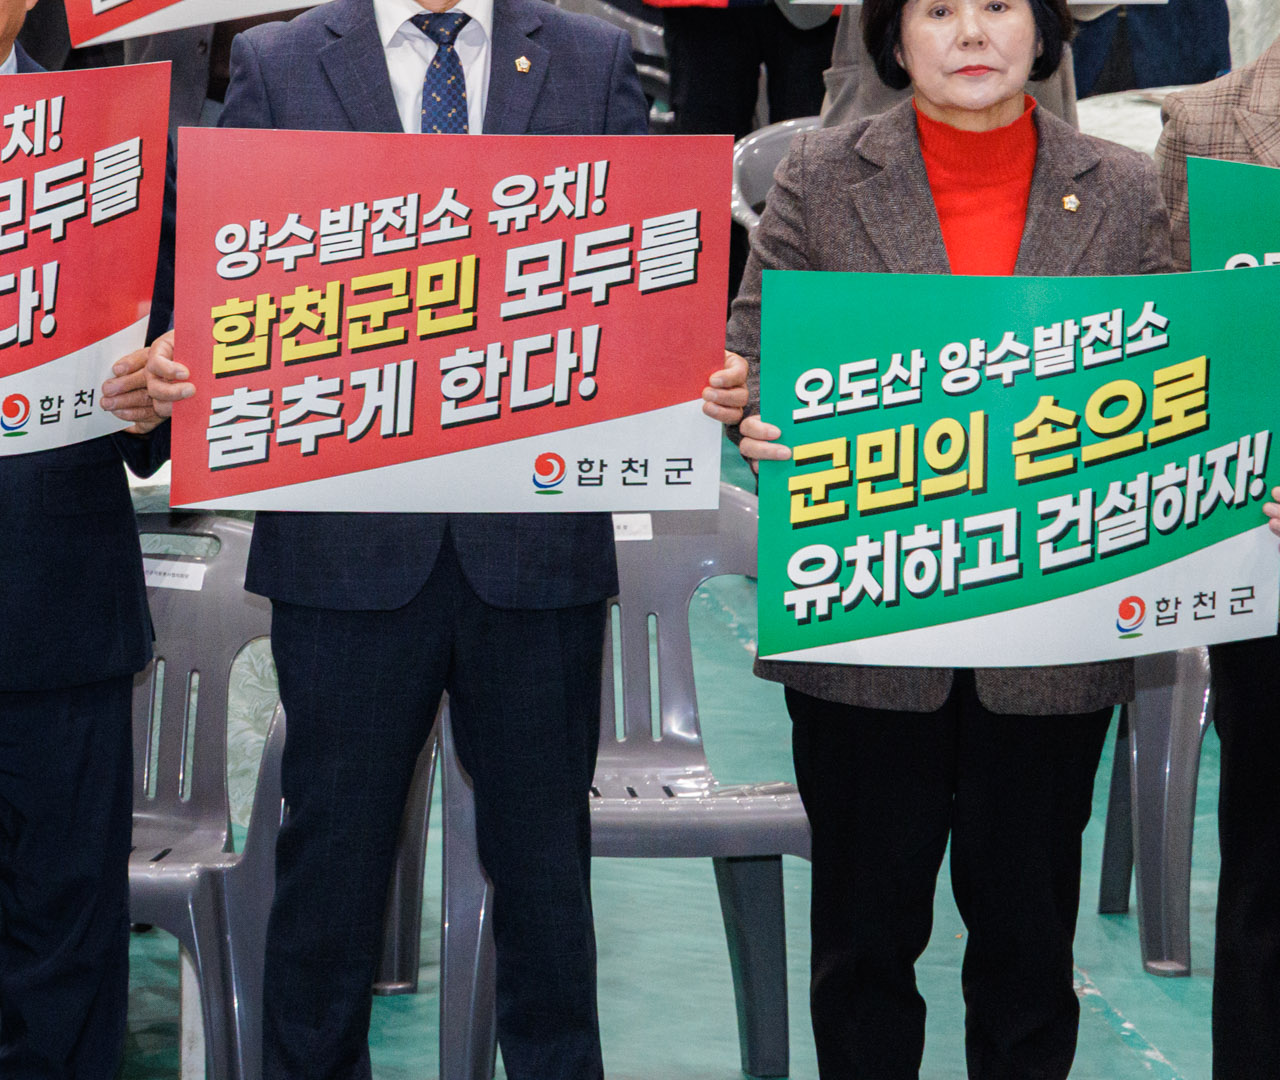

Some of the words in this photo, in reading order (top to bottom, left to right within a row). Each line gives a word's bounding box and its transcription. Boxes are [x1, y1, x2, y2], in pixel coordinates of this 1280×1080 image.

[213, 188, 473, 280] 양수발전소
[487, 160, 609, 234] 유치!
[210, 254, 478, 376] 합천군민
[499, 208, 700, 320] 모두를
[206, 359, 416, 471] 춤추게
[439, 325, 601, 427] 한다!
[791, 349, 926, 422] 오도산
[939, 301, 1170, 397] 양수발전소
[576, 456, 695, 488] 합천군
[788, 410, 986, 524] 군민의
[1012, 355, 1208, 482] 손으로
[784, 507, 1022, 621] 유치하고
[1036, 430, 1271, 571] 건설하자!
[1154, 585, 1256, 628] 합천군
